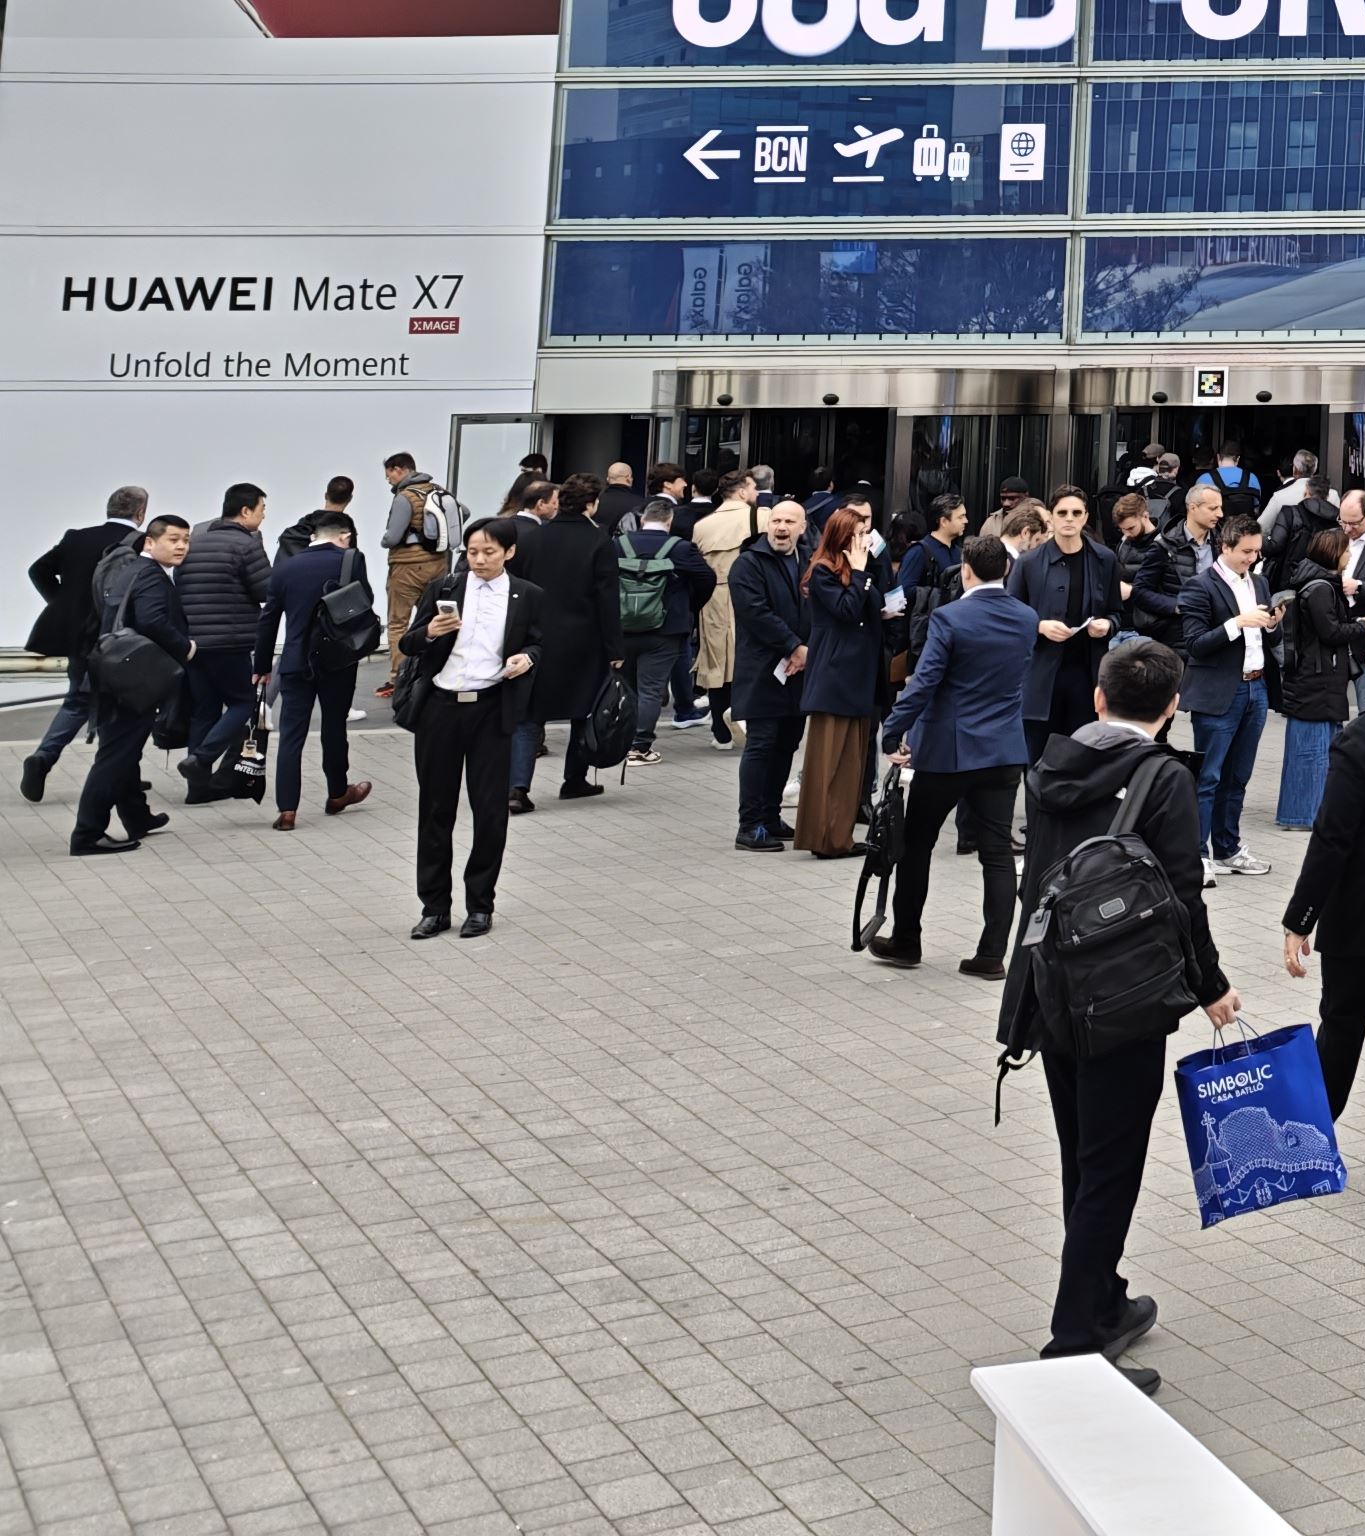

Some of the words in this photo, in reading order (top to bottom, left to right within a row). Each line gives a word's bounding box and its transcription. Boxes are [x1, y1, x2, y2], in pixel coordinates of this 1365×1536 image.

[754, 136, 808, 172] BCN
[62, 277, 274, 312] HUAWEI
[293, 276, 397, 311] Mate
[412, 274, 464, 310] X7
[109, 351, 211, 378] Unfold
[224, 351, 271, 378] the
[284, 352, 410, 378] Moment
[1198, 1064, 1273, 1099] SIMBOLIC
[1211, 1092, 1234, 1104] CASA
